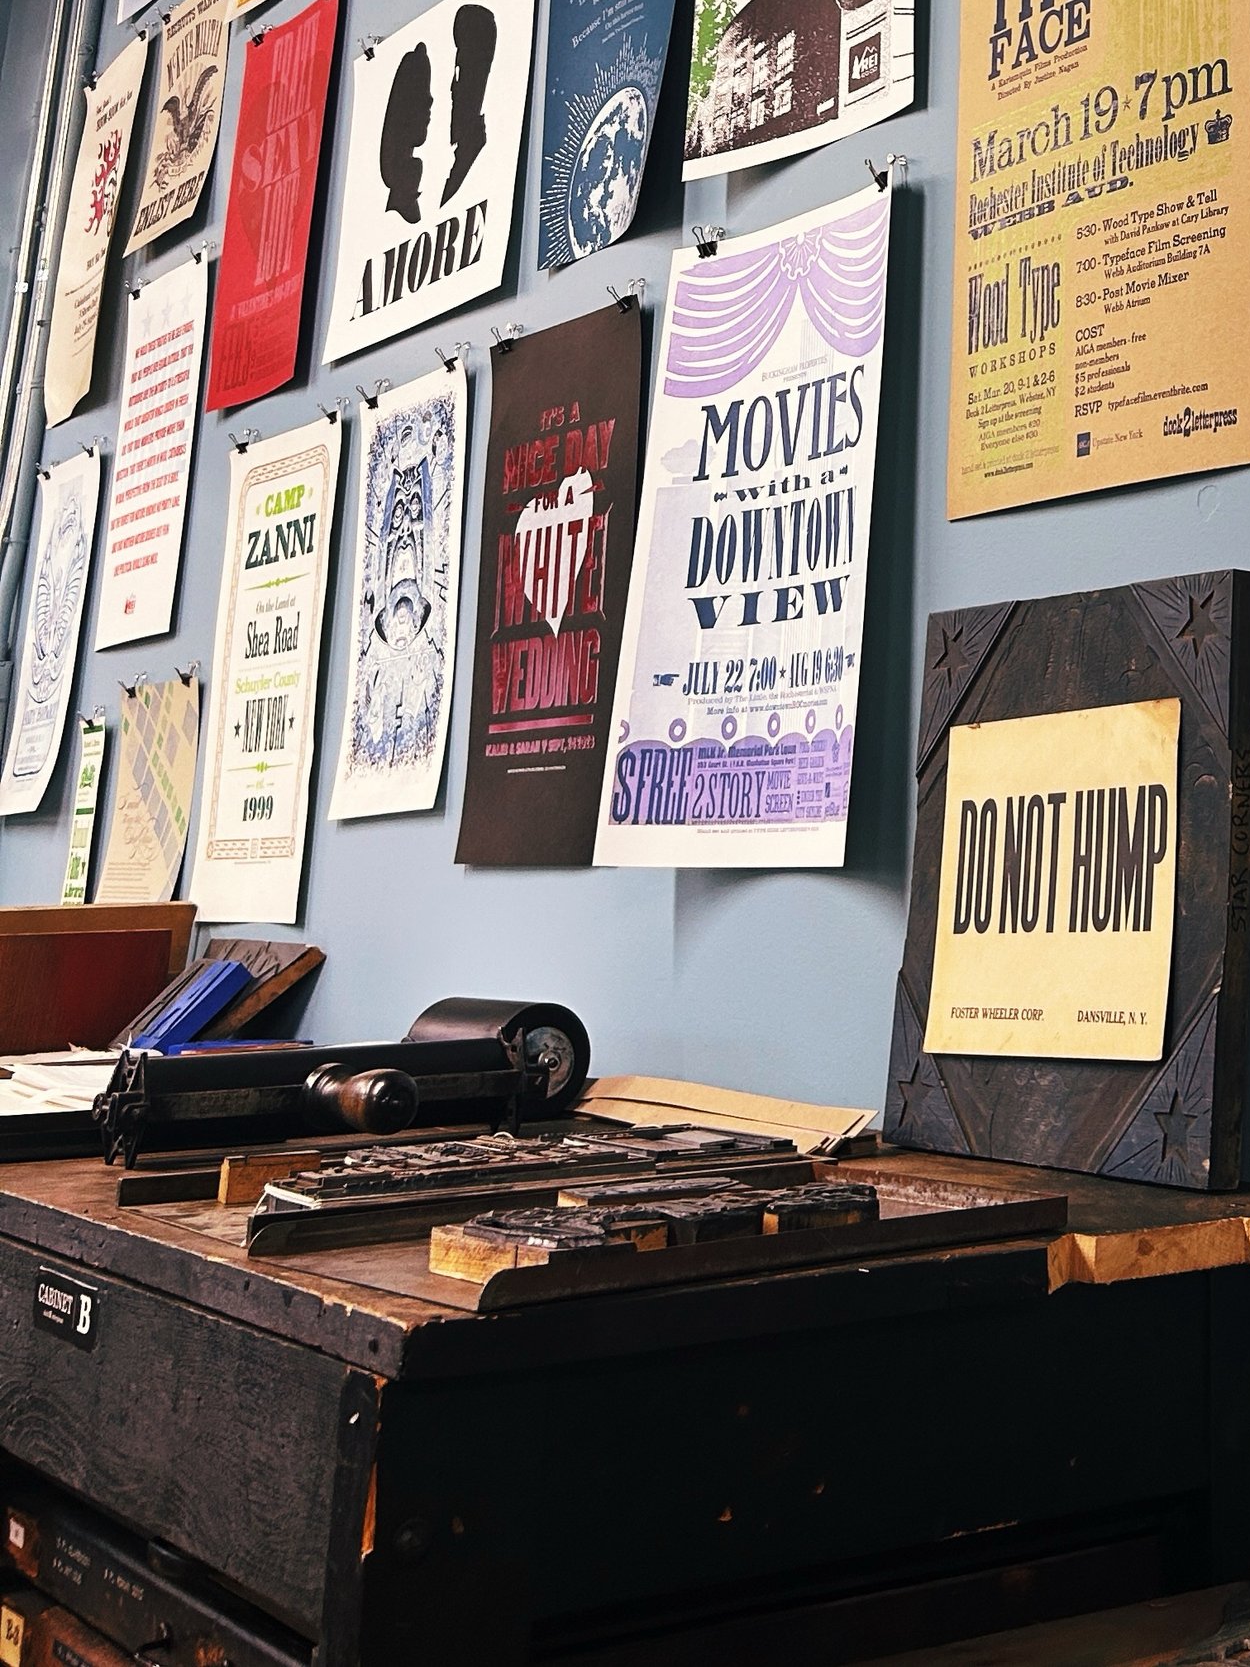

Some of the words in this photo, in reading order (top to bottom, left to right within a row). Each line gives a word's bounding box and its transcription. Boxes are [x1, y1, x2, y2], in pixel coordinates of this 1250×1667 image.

[970, 104, 1073, 184] March
[1079, 85, 1119, 141] 19
[1134, 58, 1233, 122] 7pm
[133, 189, 170, 237] ENLIST
[171, 170, 205, 213] HERE
[968, 180, 1028, 228] Rochester
[1031, 153, 1091, 203] Institute
[1093, 143, 1107, 182] of
[1110, 122, 1200, 177] Technology
[968, 199, 1055, 241] WEBB
[1061, 176, 1134, 208] AUD.
[1102, 213, 1129, 232] Wood
[1131, 210, 1155, 225] Type
[1156, 200, 1184, 217] Show
[1186, 195, 1195, 208] &
[1196, 189, 1217, 206] Tell
[349, 199, 488, 322] AMORE
[969, 342, 1056, 379] WORKSHOPS
[1075, 324, 1105, 343] COST
[692, 364, 865, 482] MOVIES
[1074, 400, 1103, 418] RSVP
[501, 432, 559, 494] NICE
[735, 474, 812, 502] with
[820, 469, 835, 485] a
[264, 484, 306, 518] CAMP
[244, 512, 317, 571] ZANNI
[685, 485, 857, 589] DOWNTOWN
[500, 515, 603, 628] WHITE
[688, 574, 851, 630] VIEW
[244, 616, 269, 660] Shea
[274, 611, 301, 654] Road
[490, 630, 600, 714] WEDDING
[682, 661, 722, 696] JULY
[723, 659, 744, 694] 22
[749, 656, 777, 692] 7:00
[789, 652, 809, 688] AUG
[811, 649, 822, 684] 19
[241, 699, 264, 753] NEW
[266, 694, 289, 751] YORK
[242, 795, 274, 822] 1999
[953, 798, 998, 934] DO
[999, 792, 1067, 934] NOT
[1069, 784, 1168, 933] HUMP
[950, 1007, 979, 1020] FOSTER
[981, 1007, 1019, 1021] WHEELER
[1021, 1008, 1045, 1022] CORP.
[1077, 1009, 1126, 1026] DANSVILLE,
[1128, 1012, 1137, 1025] N.
[1139, 1012, 1148, 1025] Y.
[38, 1283, 73, 1315] CABINET
[77, 1294, 92, 1335] B
